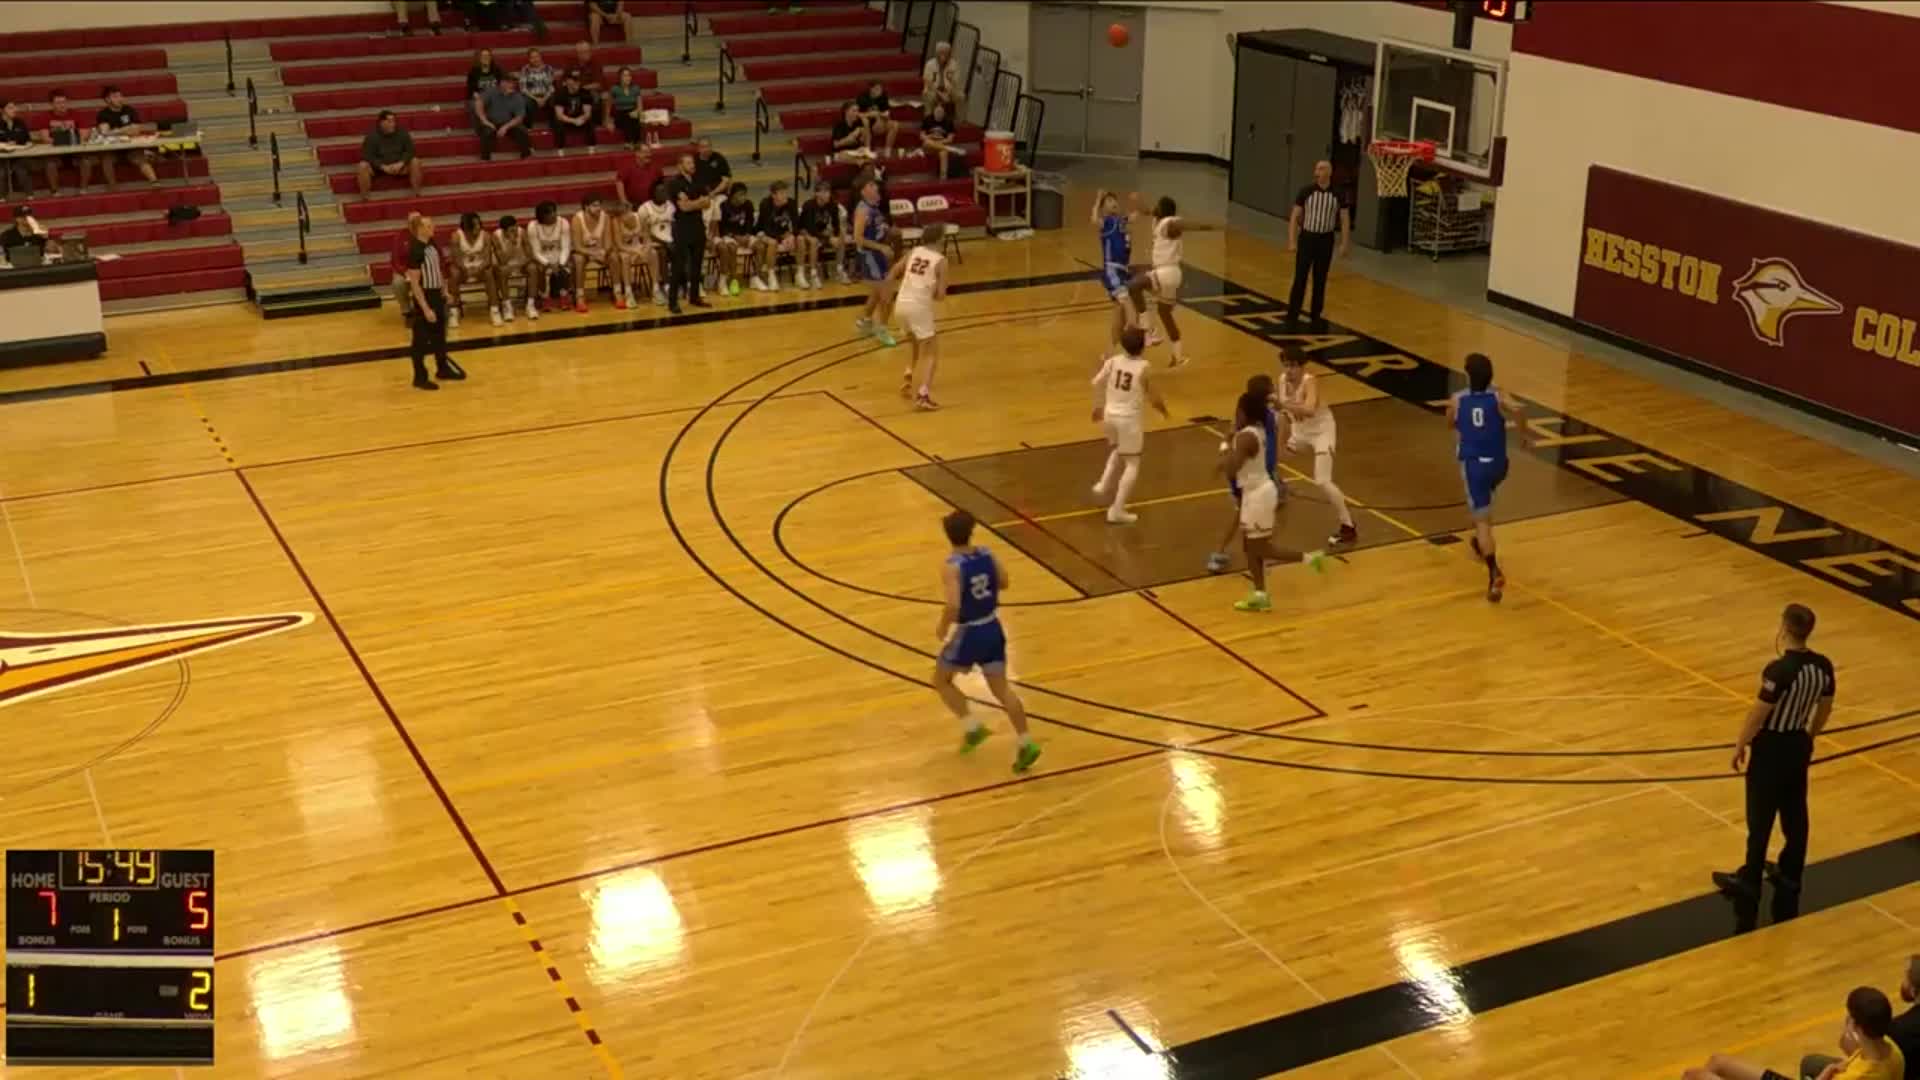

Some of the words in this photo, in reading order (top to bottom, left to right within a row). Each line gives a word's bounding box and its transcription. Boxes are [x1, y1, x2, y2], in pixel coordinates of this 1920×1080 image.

[911, 257, 930, 275] 22
[1584, 228, 1722, 304] HESSTON
[1852, 306, 1920, 367] COL
[1115, 369, 1133, 391] 13
[1471, 407, 1484, 428] 0
[1183, 294, 1420, 377] FEAR
[1692, 506, 1920, 613] NE
